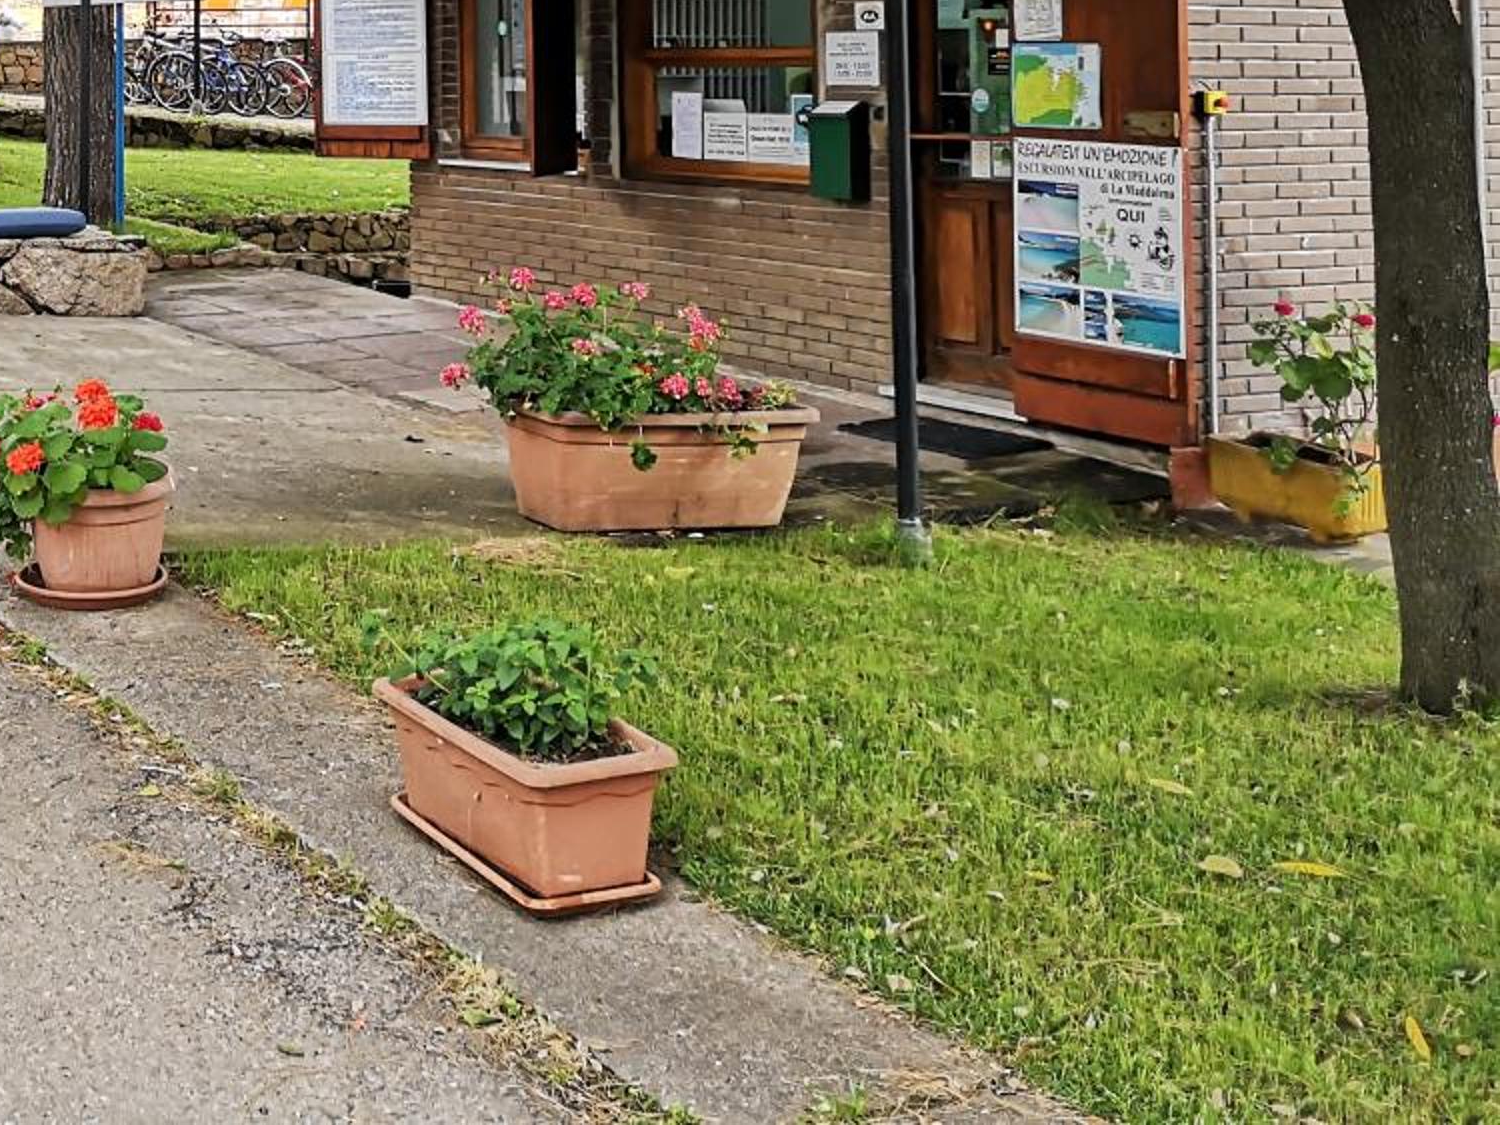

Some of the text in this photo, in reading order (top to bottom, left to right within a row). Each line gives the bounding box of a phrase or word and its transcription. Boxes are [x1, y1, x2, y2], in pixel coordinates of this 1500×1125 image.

[1017, 141, 1080, 160] REGALATEVI
[1017, 162, 1175, 185] ESCURSIONI NELL'ARCIPELAGO
[1100, 183, 1175, 199] di La Maddalena
[1116, 208, 1146, 224] QUI
